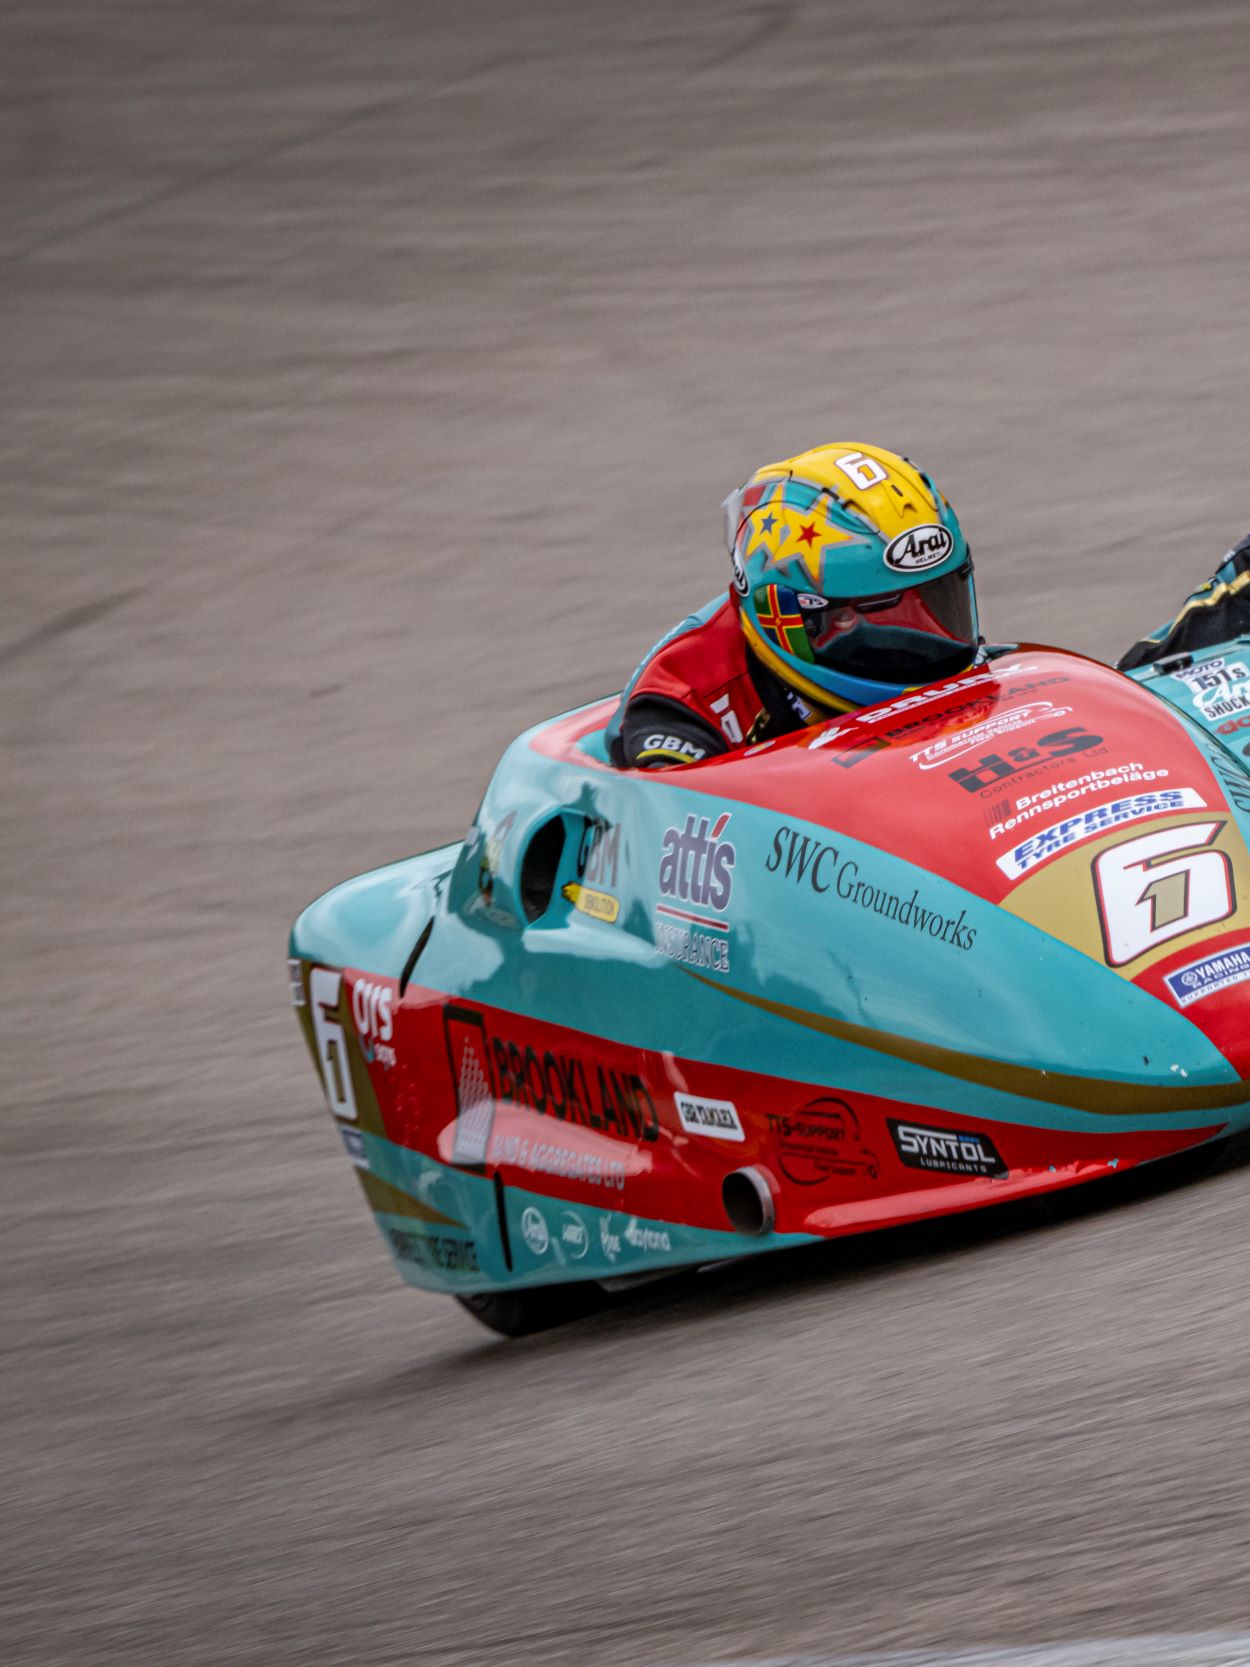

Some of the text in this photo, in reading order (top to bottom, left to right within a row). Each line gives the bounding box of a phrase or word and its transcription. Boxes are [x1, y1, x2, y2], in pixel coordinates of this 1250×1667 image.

[835, 452, 887, 490] 6
[892, 530, 949, 566] Arai
[644, 734, 705, 760] GBM
[952, 707, 1032, 742] SUPPORT
[979, 744, 1110, 800] Contractors Ltd
[1015, 761, 1144, 811] Breitenbach
[988, 768, 1169, 840] Rennsportbeläge
[1014, 790, 1184, 862] EXPRESS
[1017, 800, 1185, 870] TYRE SERVICE
[765, 825, 978, 952] SWC Groundworks
[1091, 819, 1237, 967] 6
[493, 1036, 660, 1142] BROOKLAND
[898, 1125, 997, 1164] SYNTOL
[919, 1157, 988, 1174] LUBRICANTS
